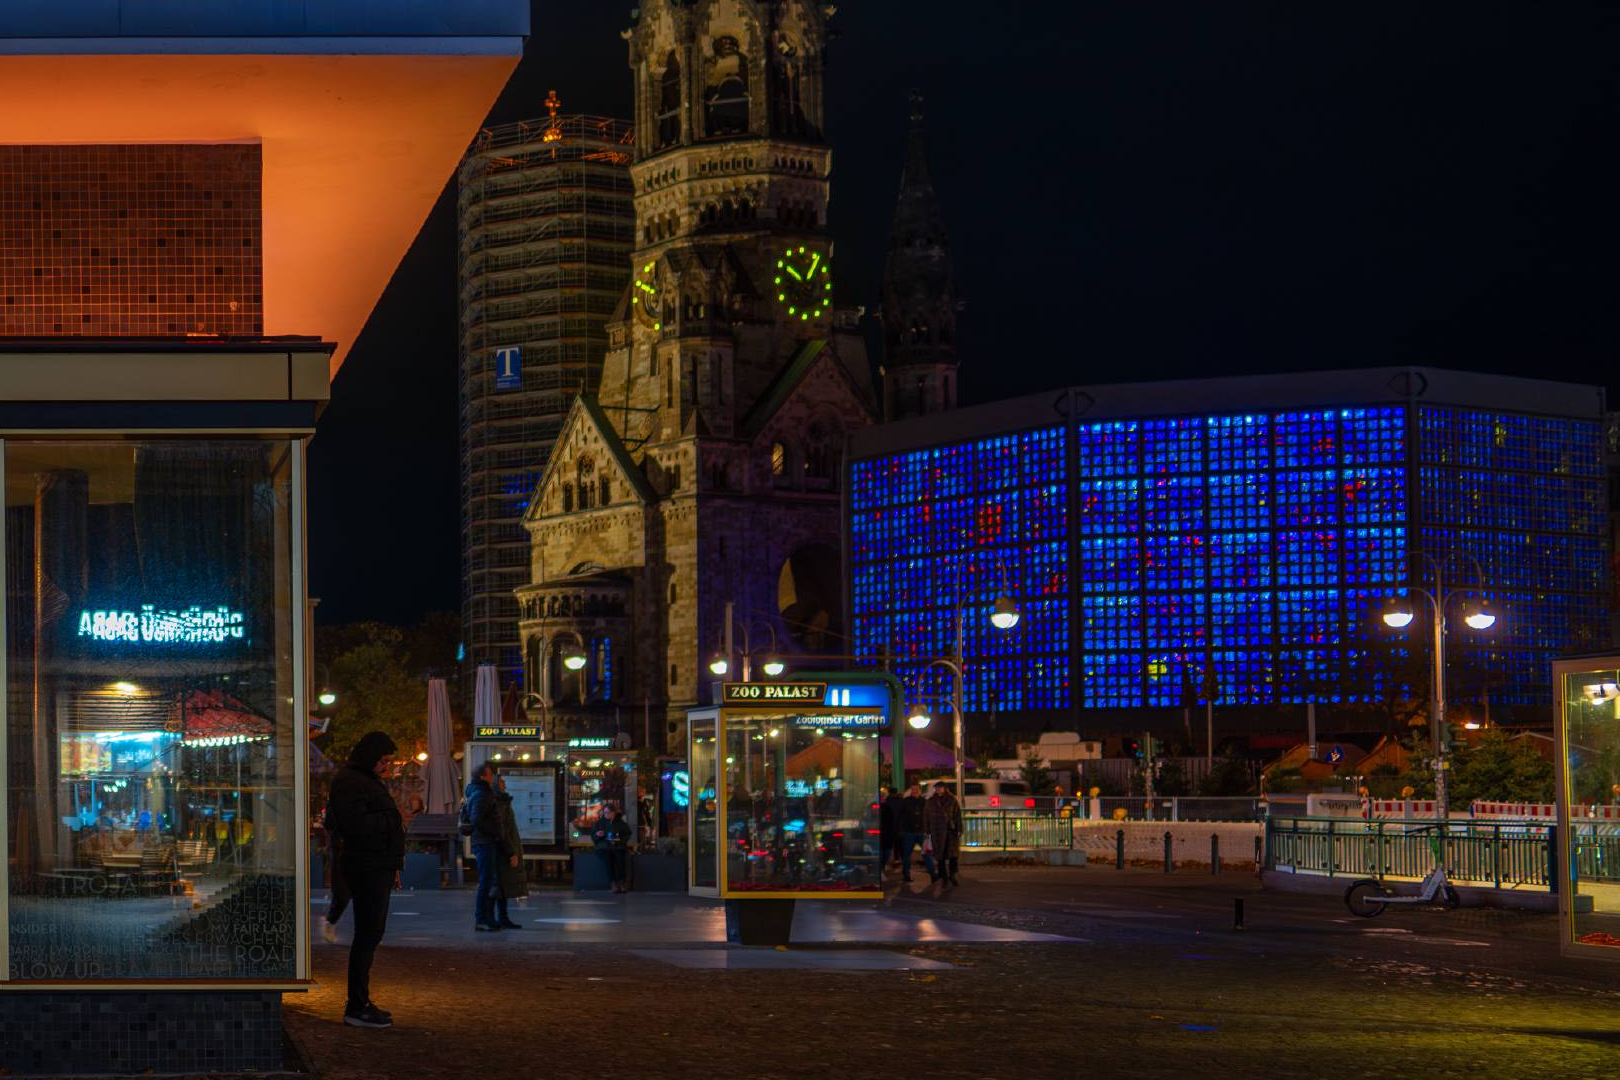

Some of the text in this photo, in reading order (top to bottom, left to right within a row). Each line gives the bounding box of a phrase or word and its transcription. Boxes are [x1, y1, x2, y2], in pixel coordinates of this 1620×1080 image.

[731, 686, 818, 698] ZOO PALAST
[796, 714, 853, 725] Zoologiscer
[479, 727, 537, 736] ZOO PALAST
[248, 911, 295, 925] FRIDA
[10, 923, 58, 934] NSIDER
[234, 923, 260, 935] FAIR
[186, 944, 295, 962] THE ROAD
